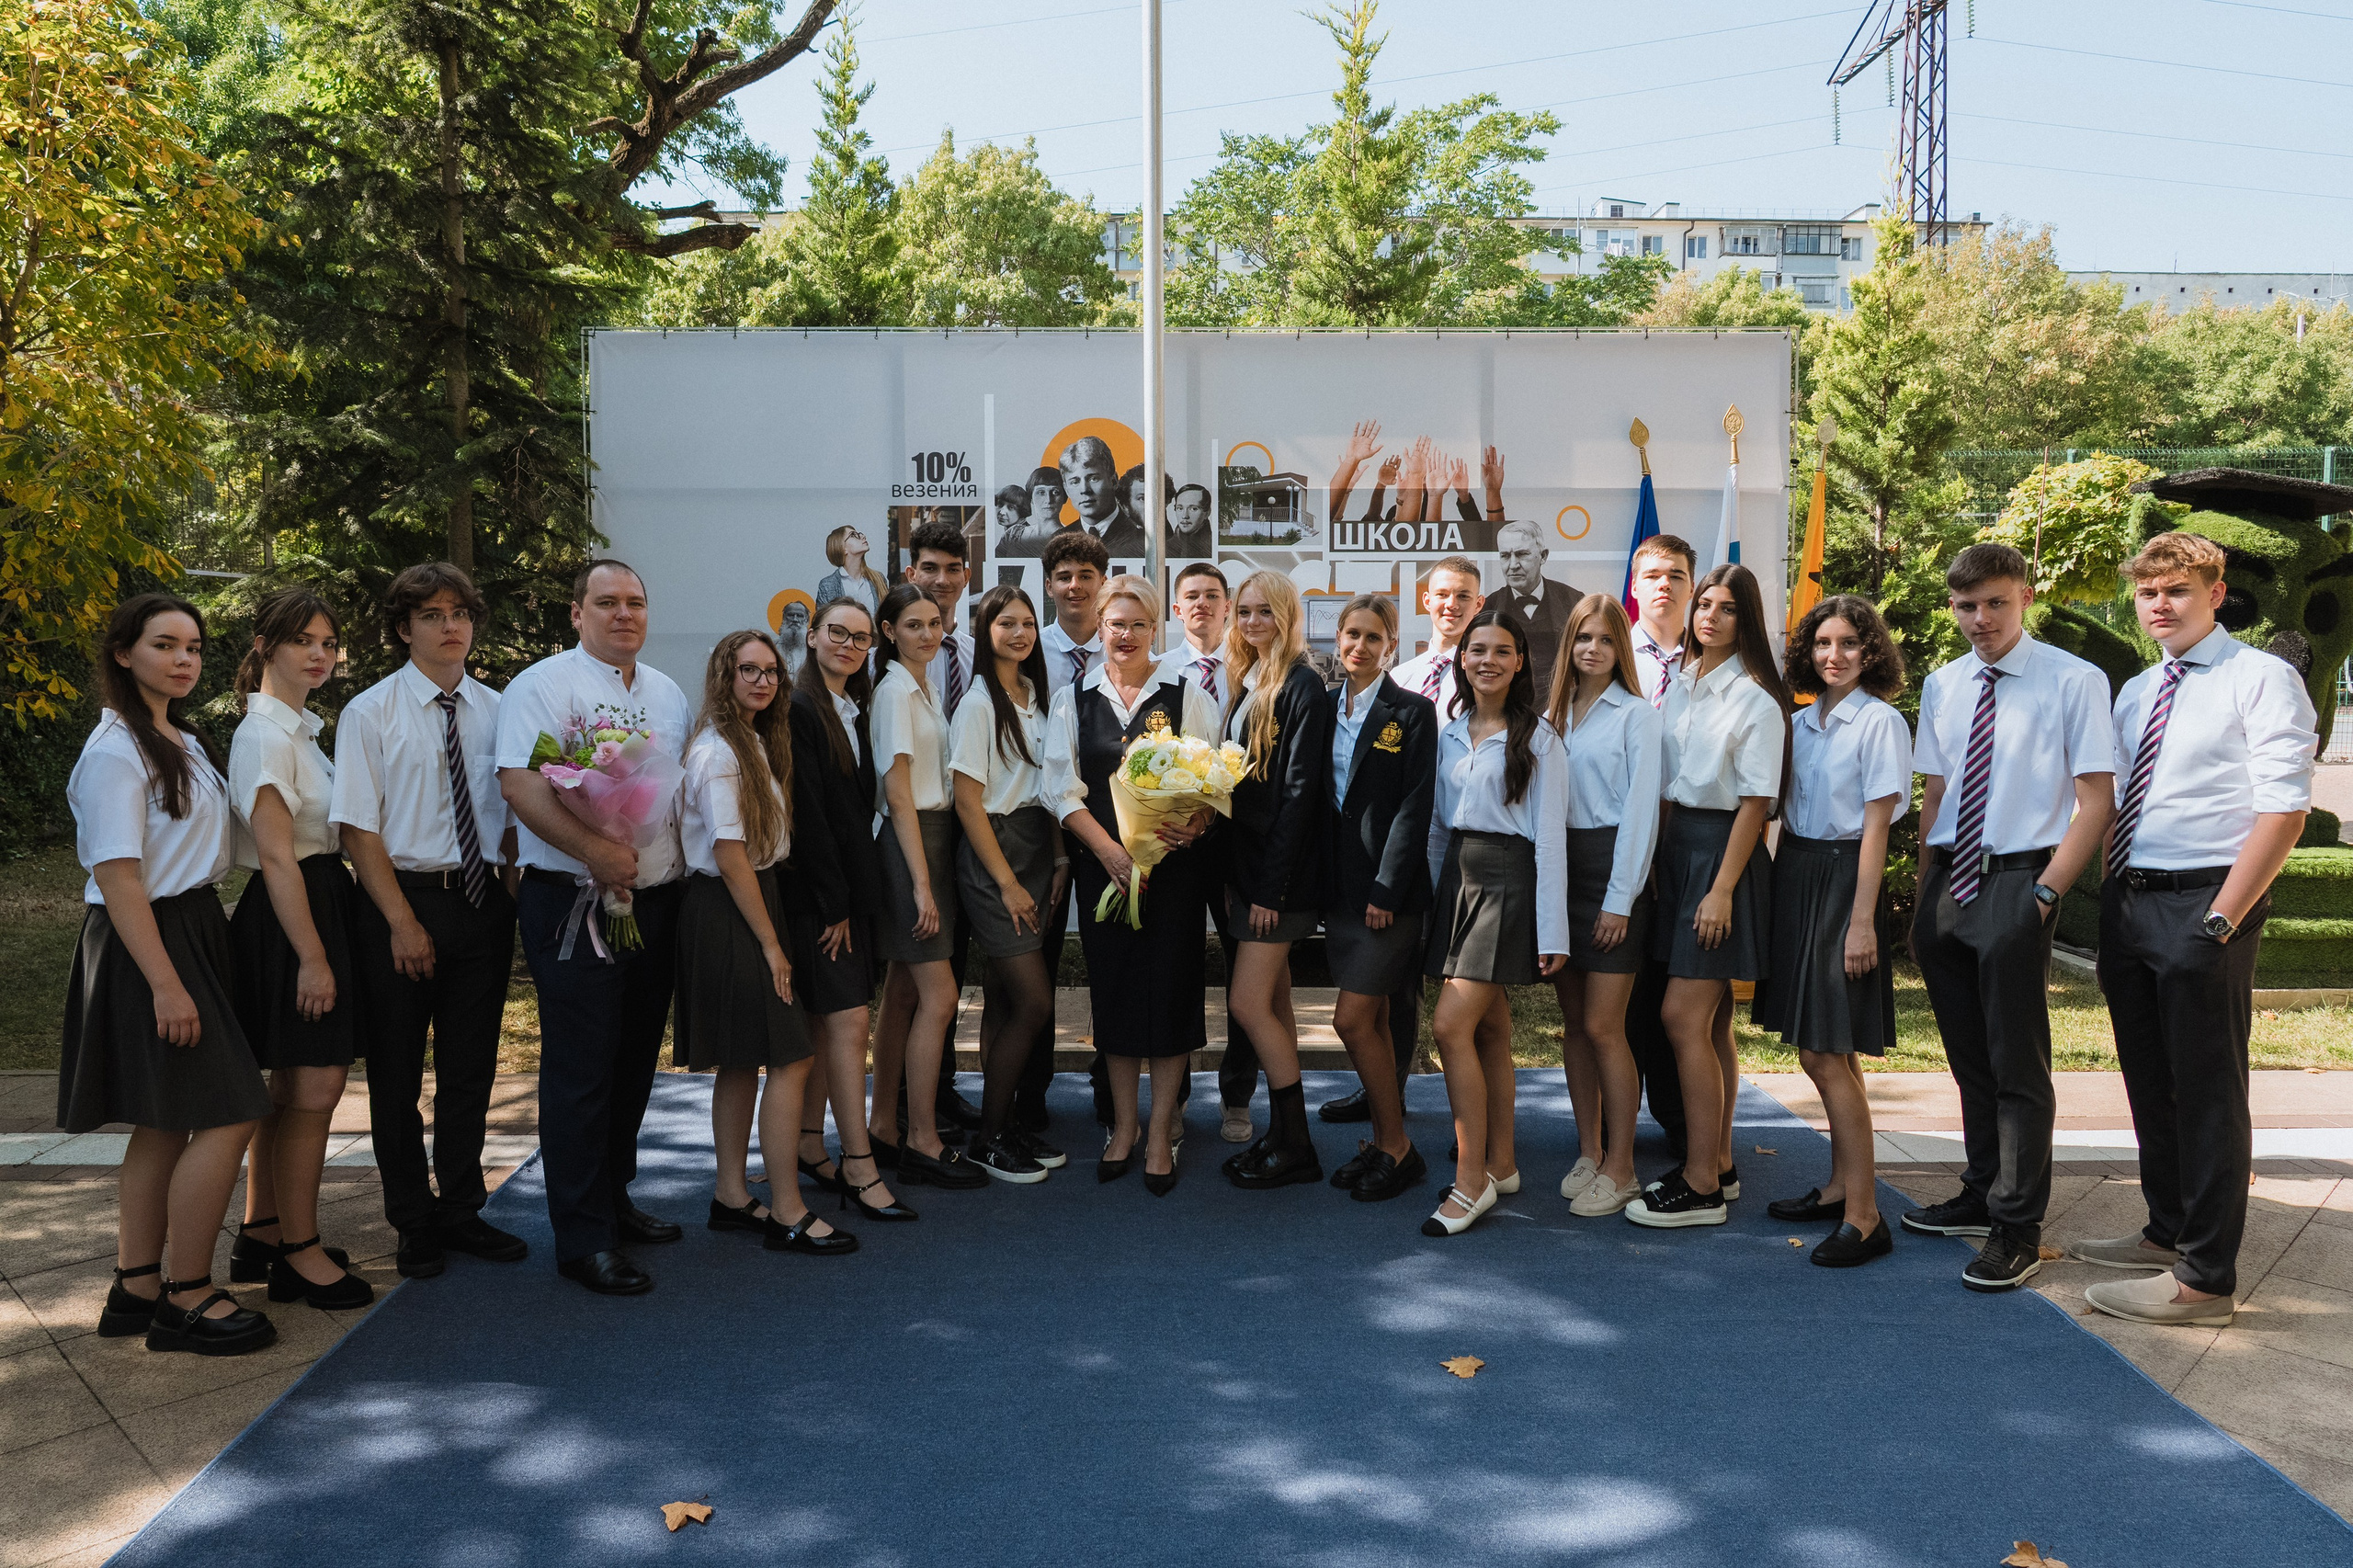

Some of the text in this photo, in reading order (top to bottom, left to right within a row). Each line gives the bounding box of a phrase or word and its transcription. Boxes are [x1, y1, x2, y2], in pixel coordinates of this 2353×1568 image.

[911, 451, 972, 483] 10%
[892, 484, 977, 497] везения
[1334, 523, 1464, 551] ШКОЛА
